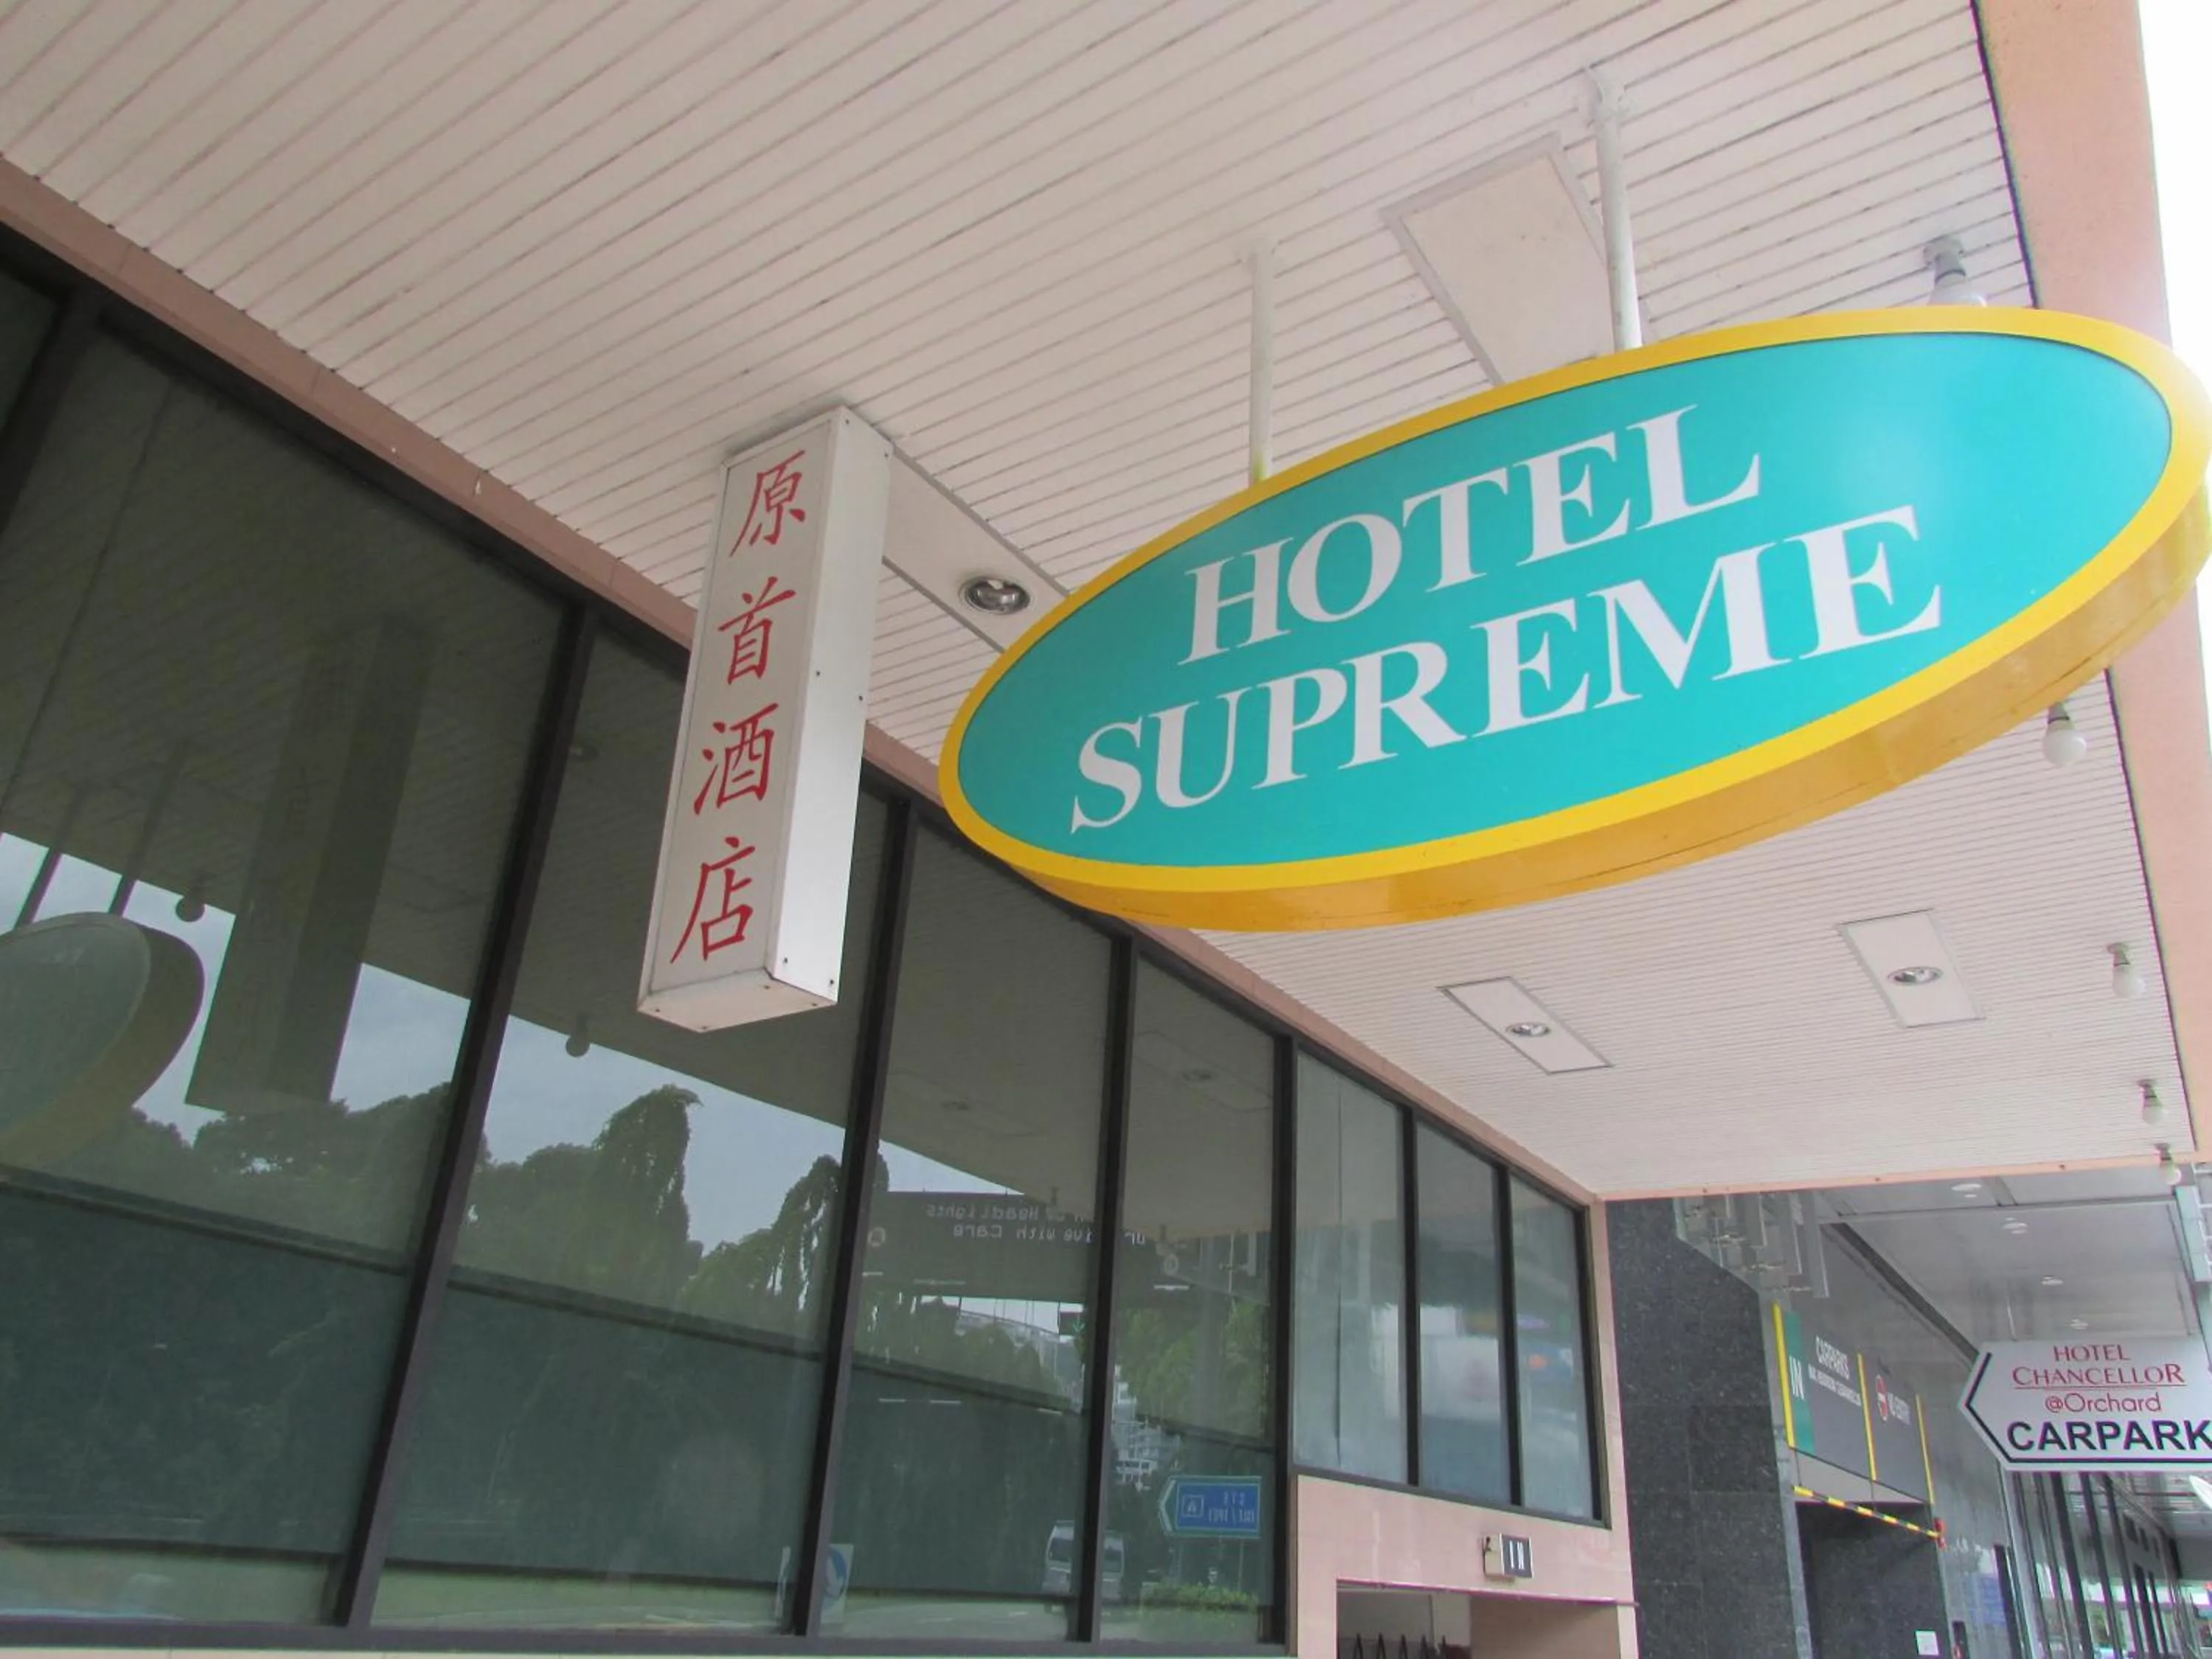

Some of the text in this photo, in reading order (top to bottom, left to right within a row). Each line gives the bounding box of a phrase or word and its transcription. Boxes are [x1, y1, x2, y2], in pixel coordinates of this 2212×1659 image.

[1177, 404, 1761, 666] HOTEL
[1070, 504, 1942, 835] SUPREME
[670, 449, 807, 964] 原首酒店
[2053, 1344, 2131, 1362] HOTEL
[1789, 1355, 1805, 1400] IN
[2012, 1363, 2186, 1385] CHANCELLOR
[2045, 1391, 2162, 1413] @Orchard
[2007, 1420, 2212, 1450] CARPARK
